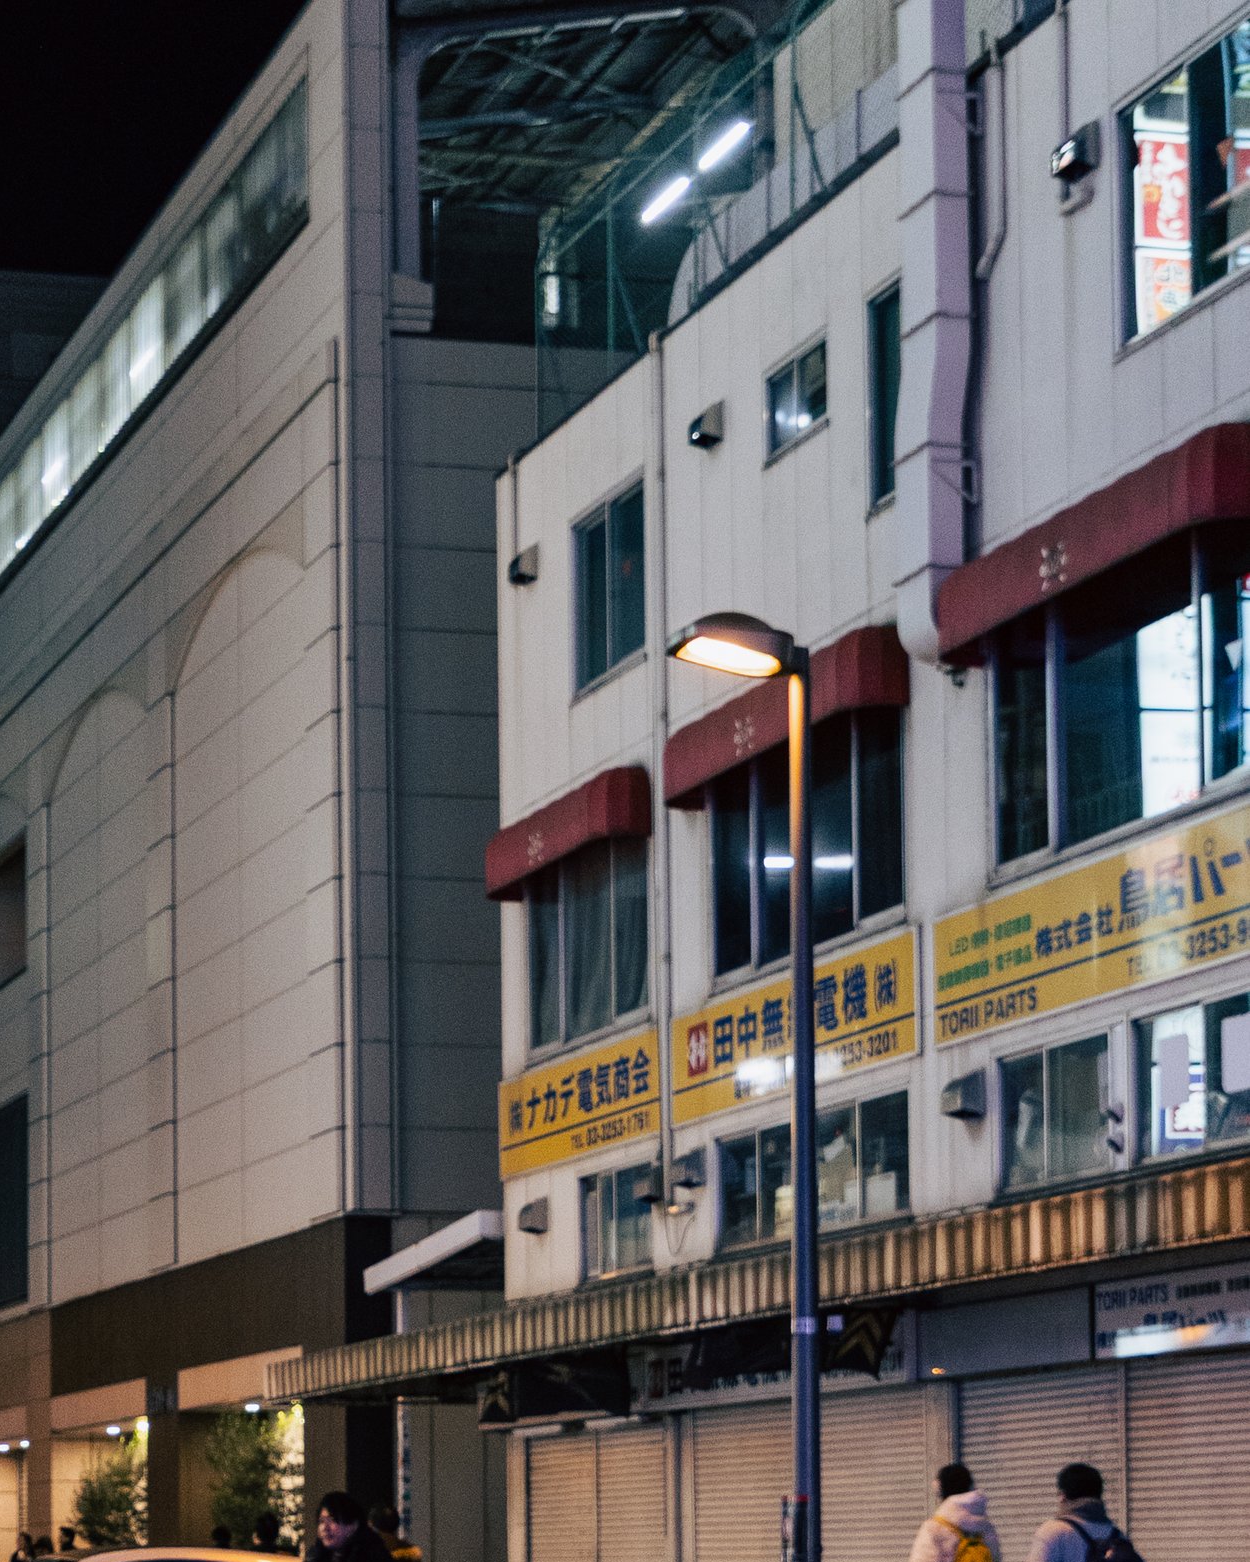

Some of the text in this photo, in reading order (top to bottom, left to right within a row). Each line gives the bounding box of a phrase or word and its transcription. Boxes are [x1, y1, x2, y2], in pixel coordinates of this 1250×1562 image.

[714, 959, 896, 1068] 田中無電機(株)
[938, 986, 1037, 1037] TORII PARTS
